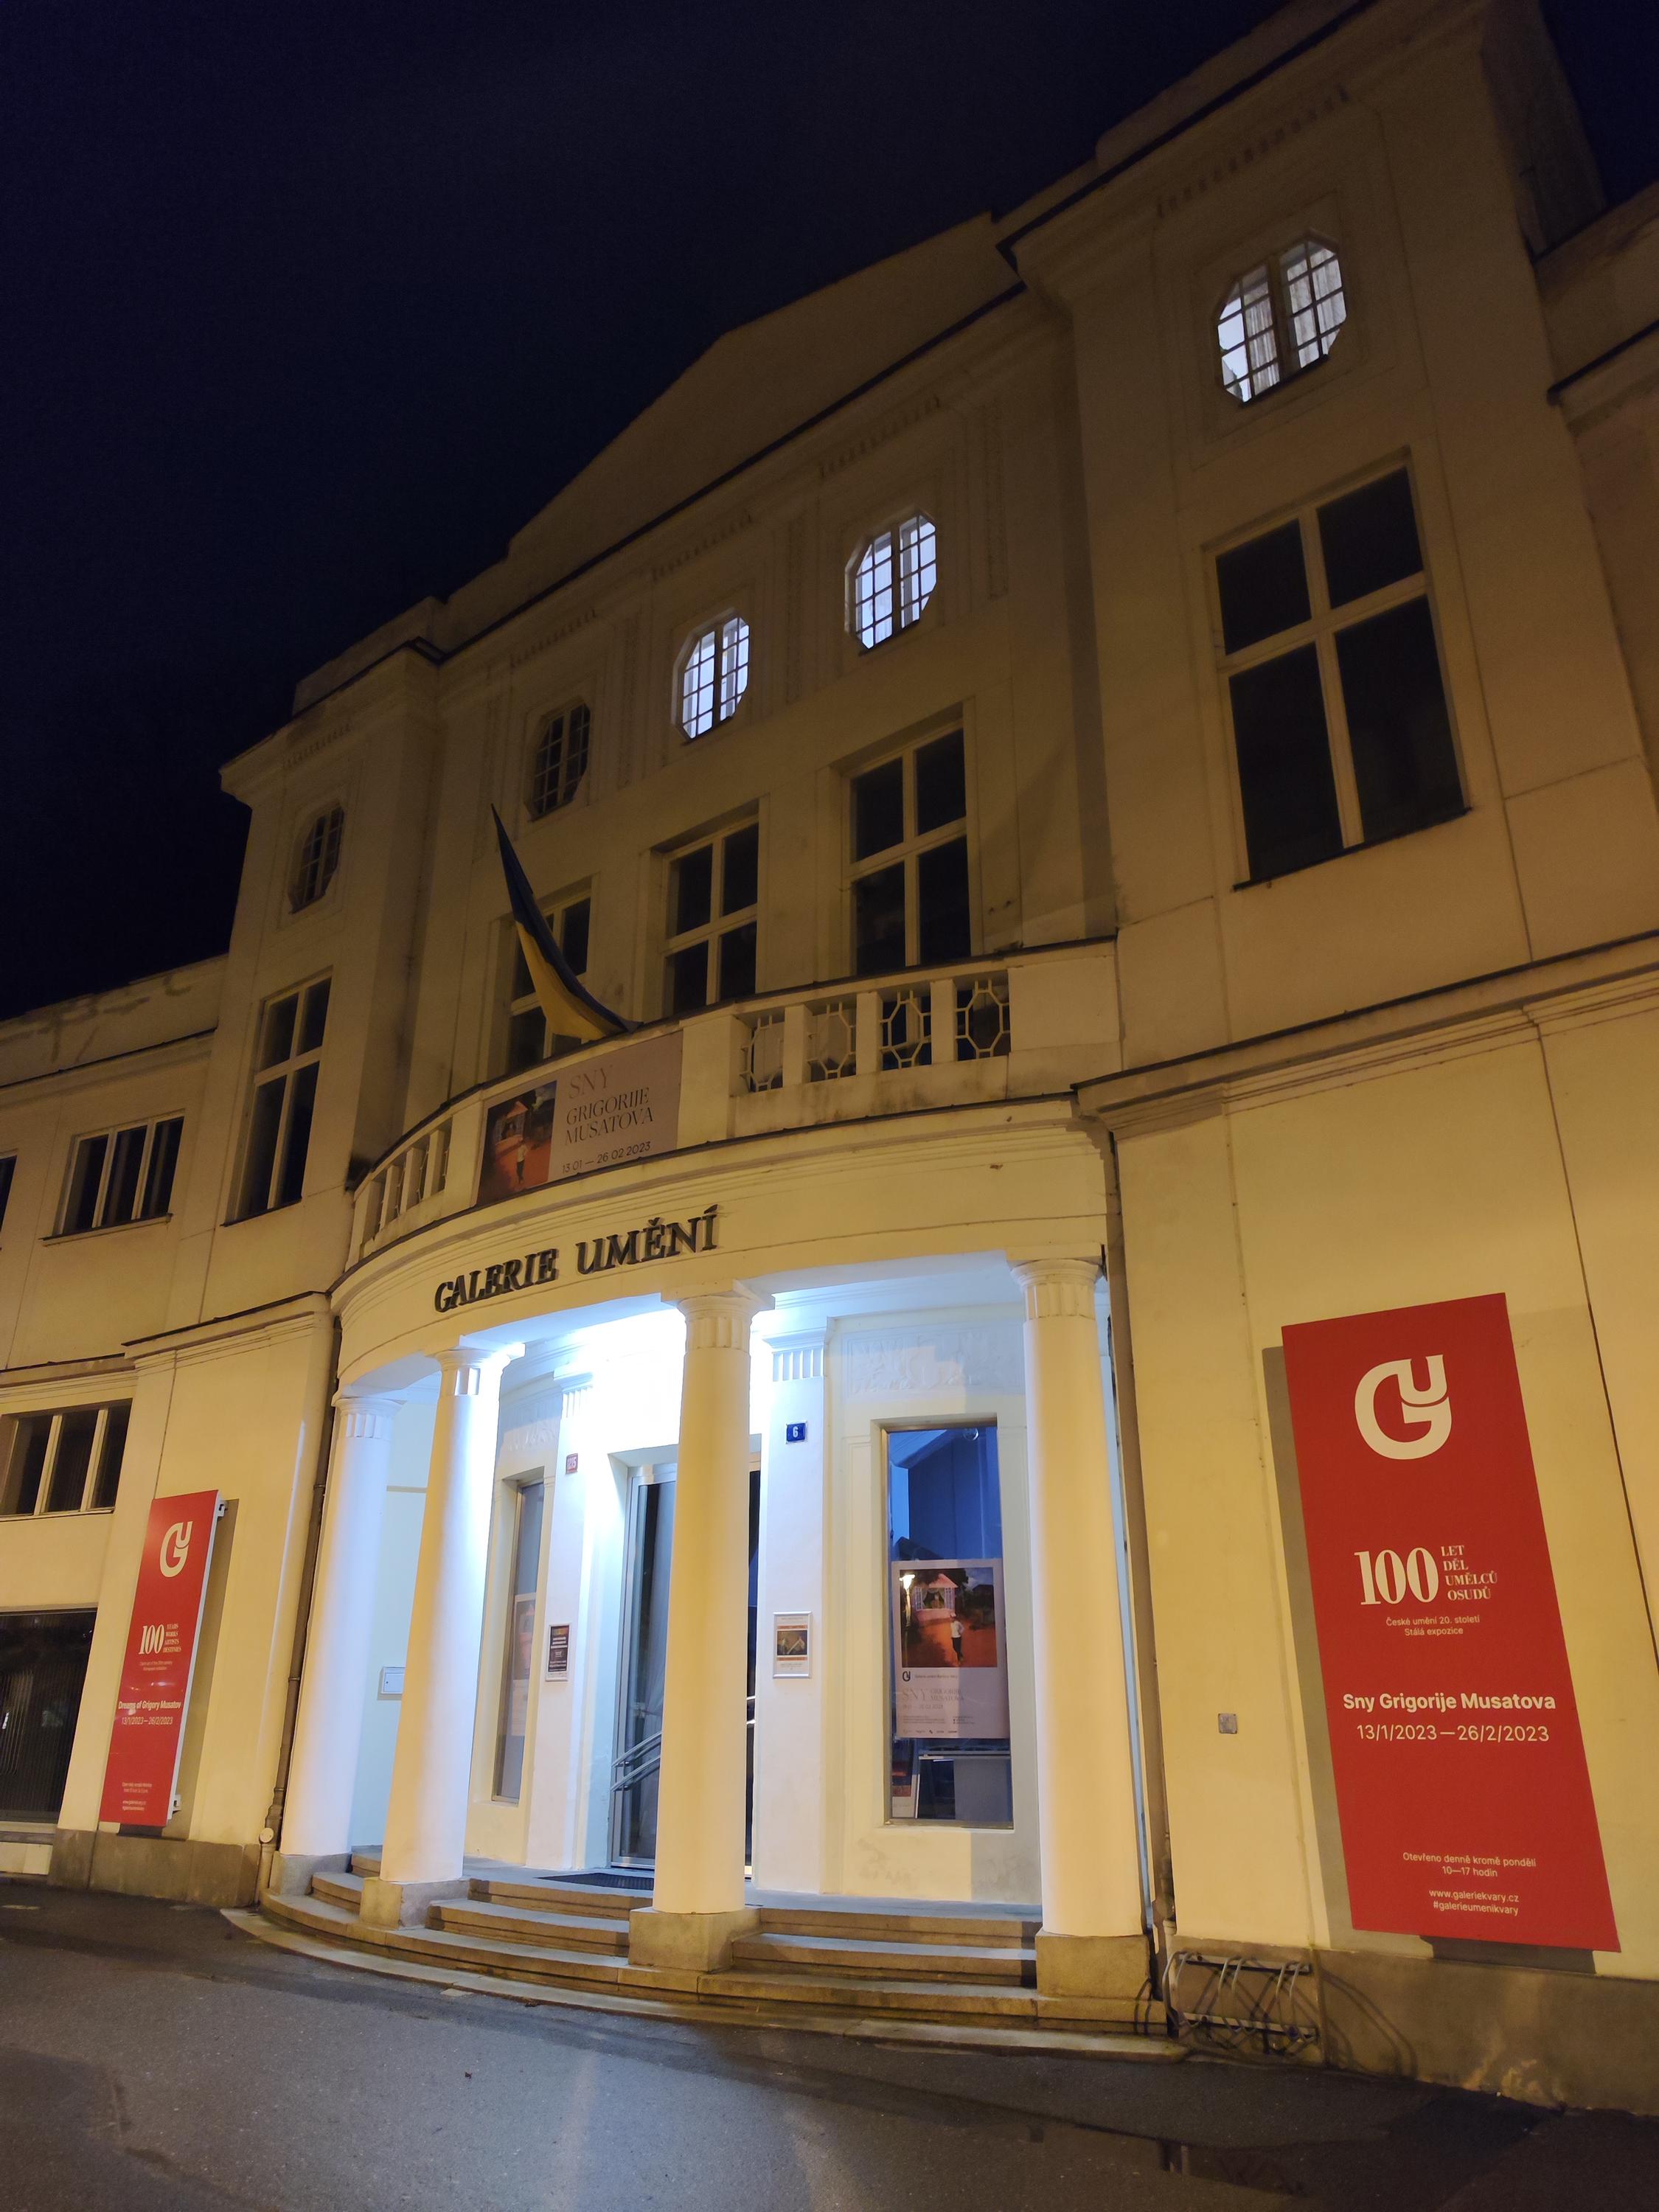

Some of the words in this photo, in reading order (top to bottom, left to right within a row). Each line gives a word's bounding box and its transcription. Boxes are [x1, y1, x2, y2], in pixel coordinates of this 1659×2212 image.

[569, 1064, 613, 1099] SNY
[566, 1107, 653, 1146] MUSATOVA
[563, 1163, 571, 1174] 13
[572, 1160, 582, 1171] 01
[597, 1152, 609, 1164] 26
[611, 1148, 625, 1160] 02
[626, 1141, 651, 1156] 2023
[434, 1248, 560, 1312] GALERIE
[575, 1204, 719, 1276] UMĚNÍ
[793, 1426, 799, 1438] 6
[1441, 1545, 1464, 1557] LET
[1443, 1558, 1469, 1571] DĚL
[1354, 1547, 1439, 1605] 100
[1444, 1570, 1498, 1586] UMĚLCŮ
[1447, 1585, 1492, 1601] OSUDŮ
[1385, 1617, 1411, 1627] České
[1413, 1615, 1437, 1625] umění
[1439, 1615, 1453, 1624] 20.
[1455, 1614, 1481, 1624] století
[138, 1624, 165, 1655] 100
[1404, 1627, 1425, 1636] Stálá
[1427, 1627, 1464, 1636] expozice
[136, 1700, 142, 1708] of
[142, 1700, 160, 1711] Grigory
[160, 1700, 181, 1708] Musatov
[1343, 1694, 1374, 1712] Sny
[1379, 1693, 1457, 1713] Grigorije
[1460, 1693, 1556, 1710] Musatova
[1403, 1852, 1441, 1863] Otevřeno
[1444, 1854, 1470, 1864] denně
[1472, 1856, 1500, 1865] kromě
[1503, 1857, 1537, 1867] pondělí
[1472, 1867, 1498, 1877] hodin
[1429, 1889, 1519, 1903] www.galeriekvary.cz
[1433, 1900, 1519, 1916] #galerieumenikvary
